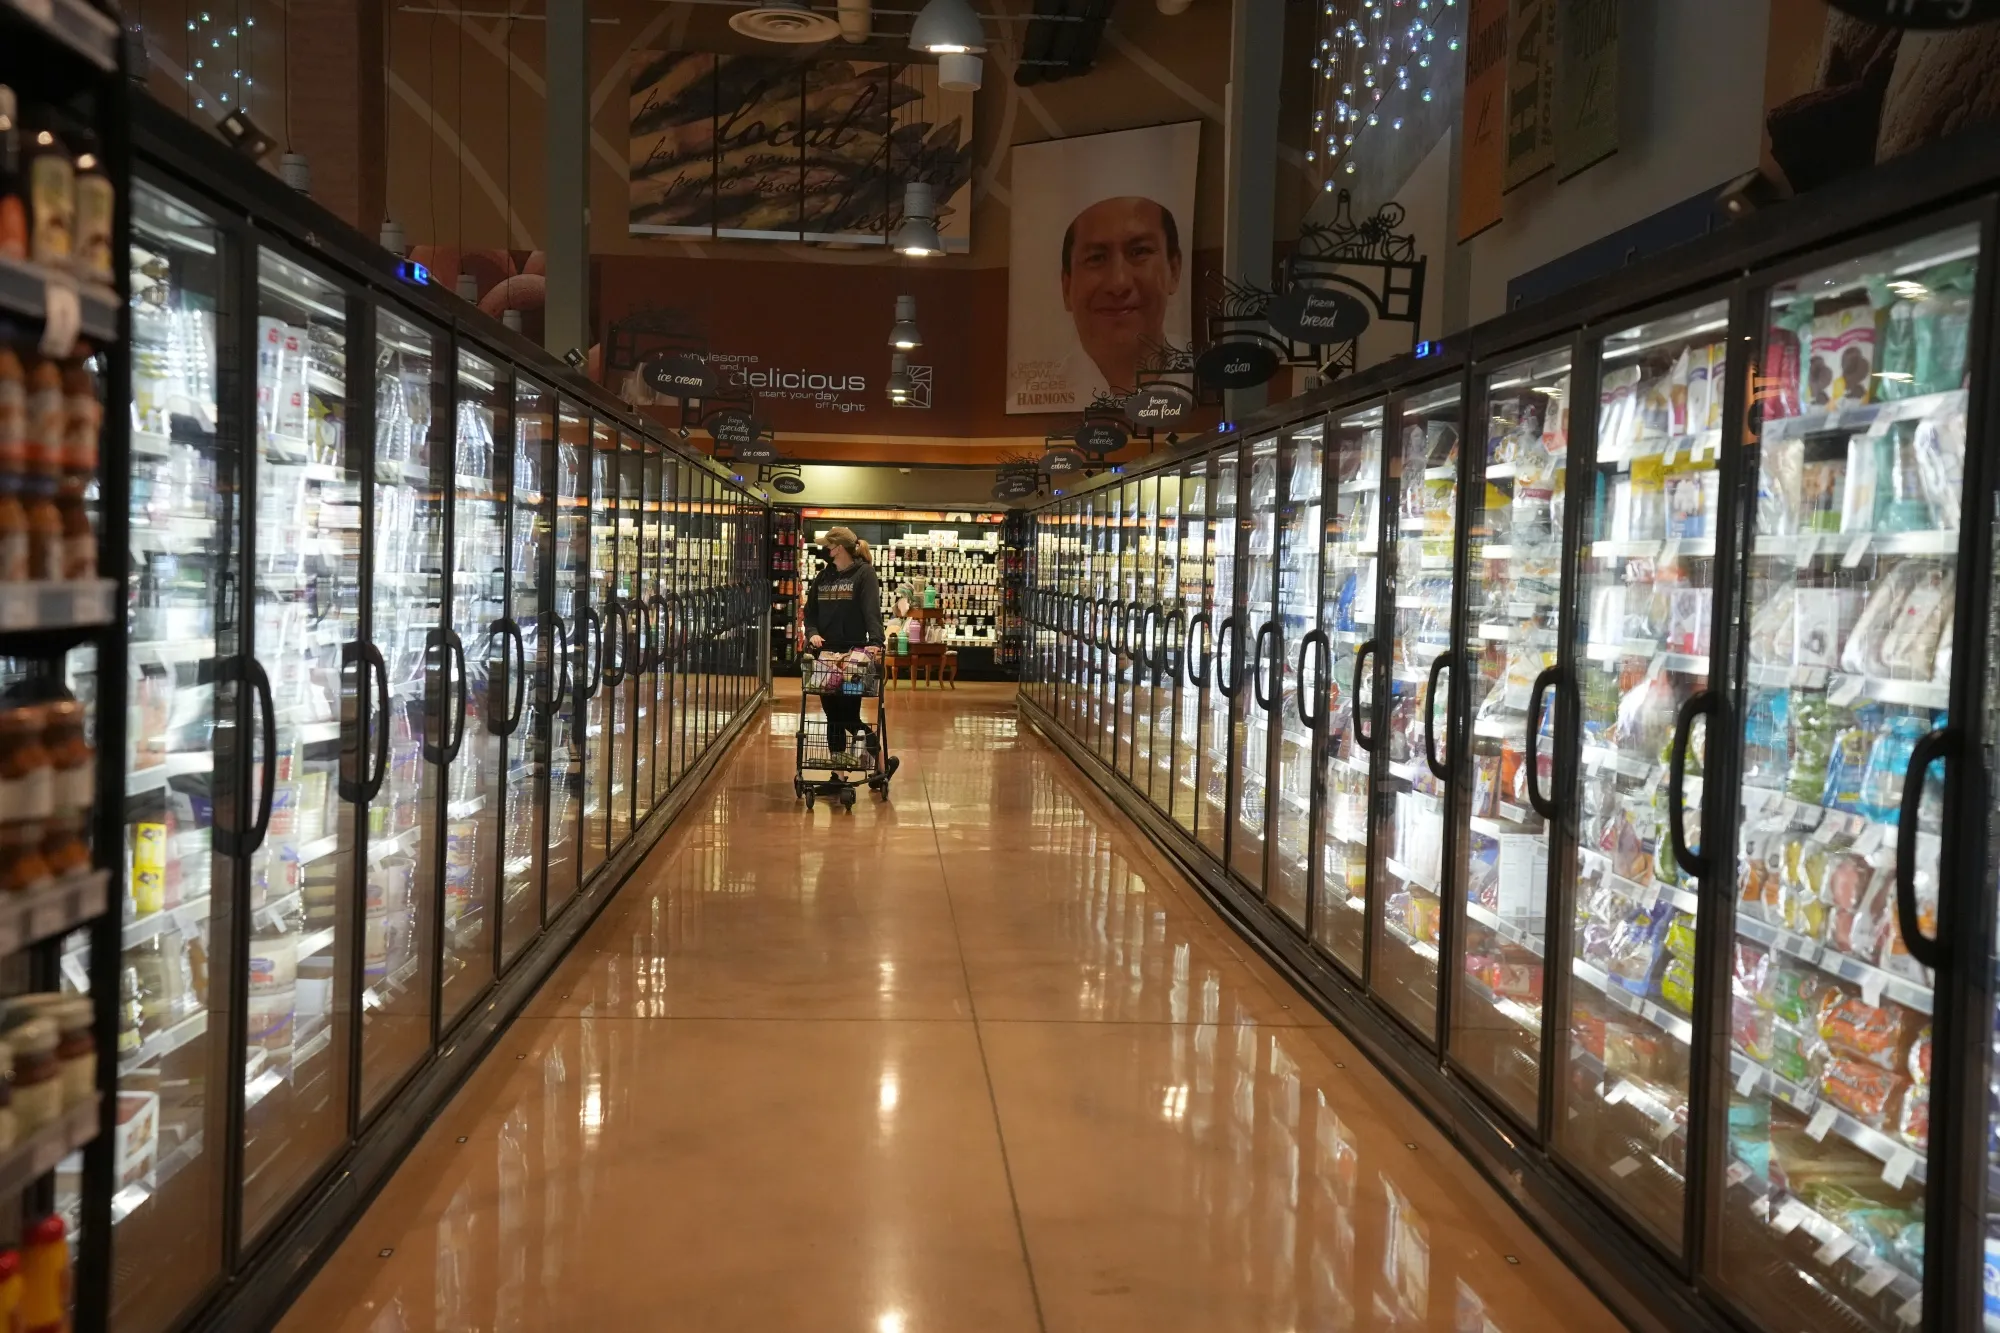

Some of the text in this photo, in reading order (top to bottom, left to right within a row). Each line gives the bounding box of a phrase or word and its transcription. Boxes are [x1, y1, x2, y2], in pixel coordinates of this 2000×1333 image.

[1508, 0, 1542, 167] HA
[716, 79, 878, 150] local
[1307, 294, 1336, 311] frozen
[1300, 310, 1339, 328] bread
[719, 363, 739, 371] and
[1224, 357, 1251, 374] asian
[657, 369, 703, 387] ice cream
[730, 368, 866, 391] delicious
[1025, 378, 1067, 391] faces
[759, 391, 839, 401] start your day
[1016, 392, 1076, 406] HARMONS
[815, 401, 866, 413] off right
[1138, 403, 1182, 419] asian food
